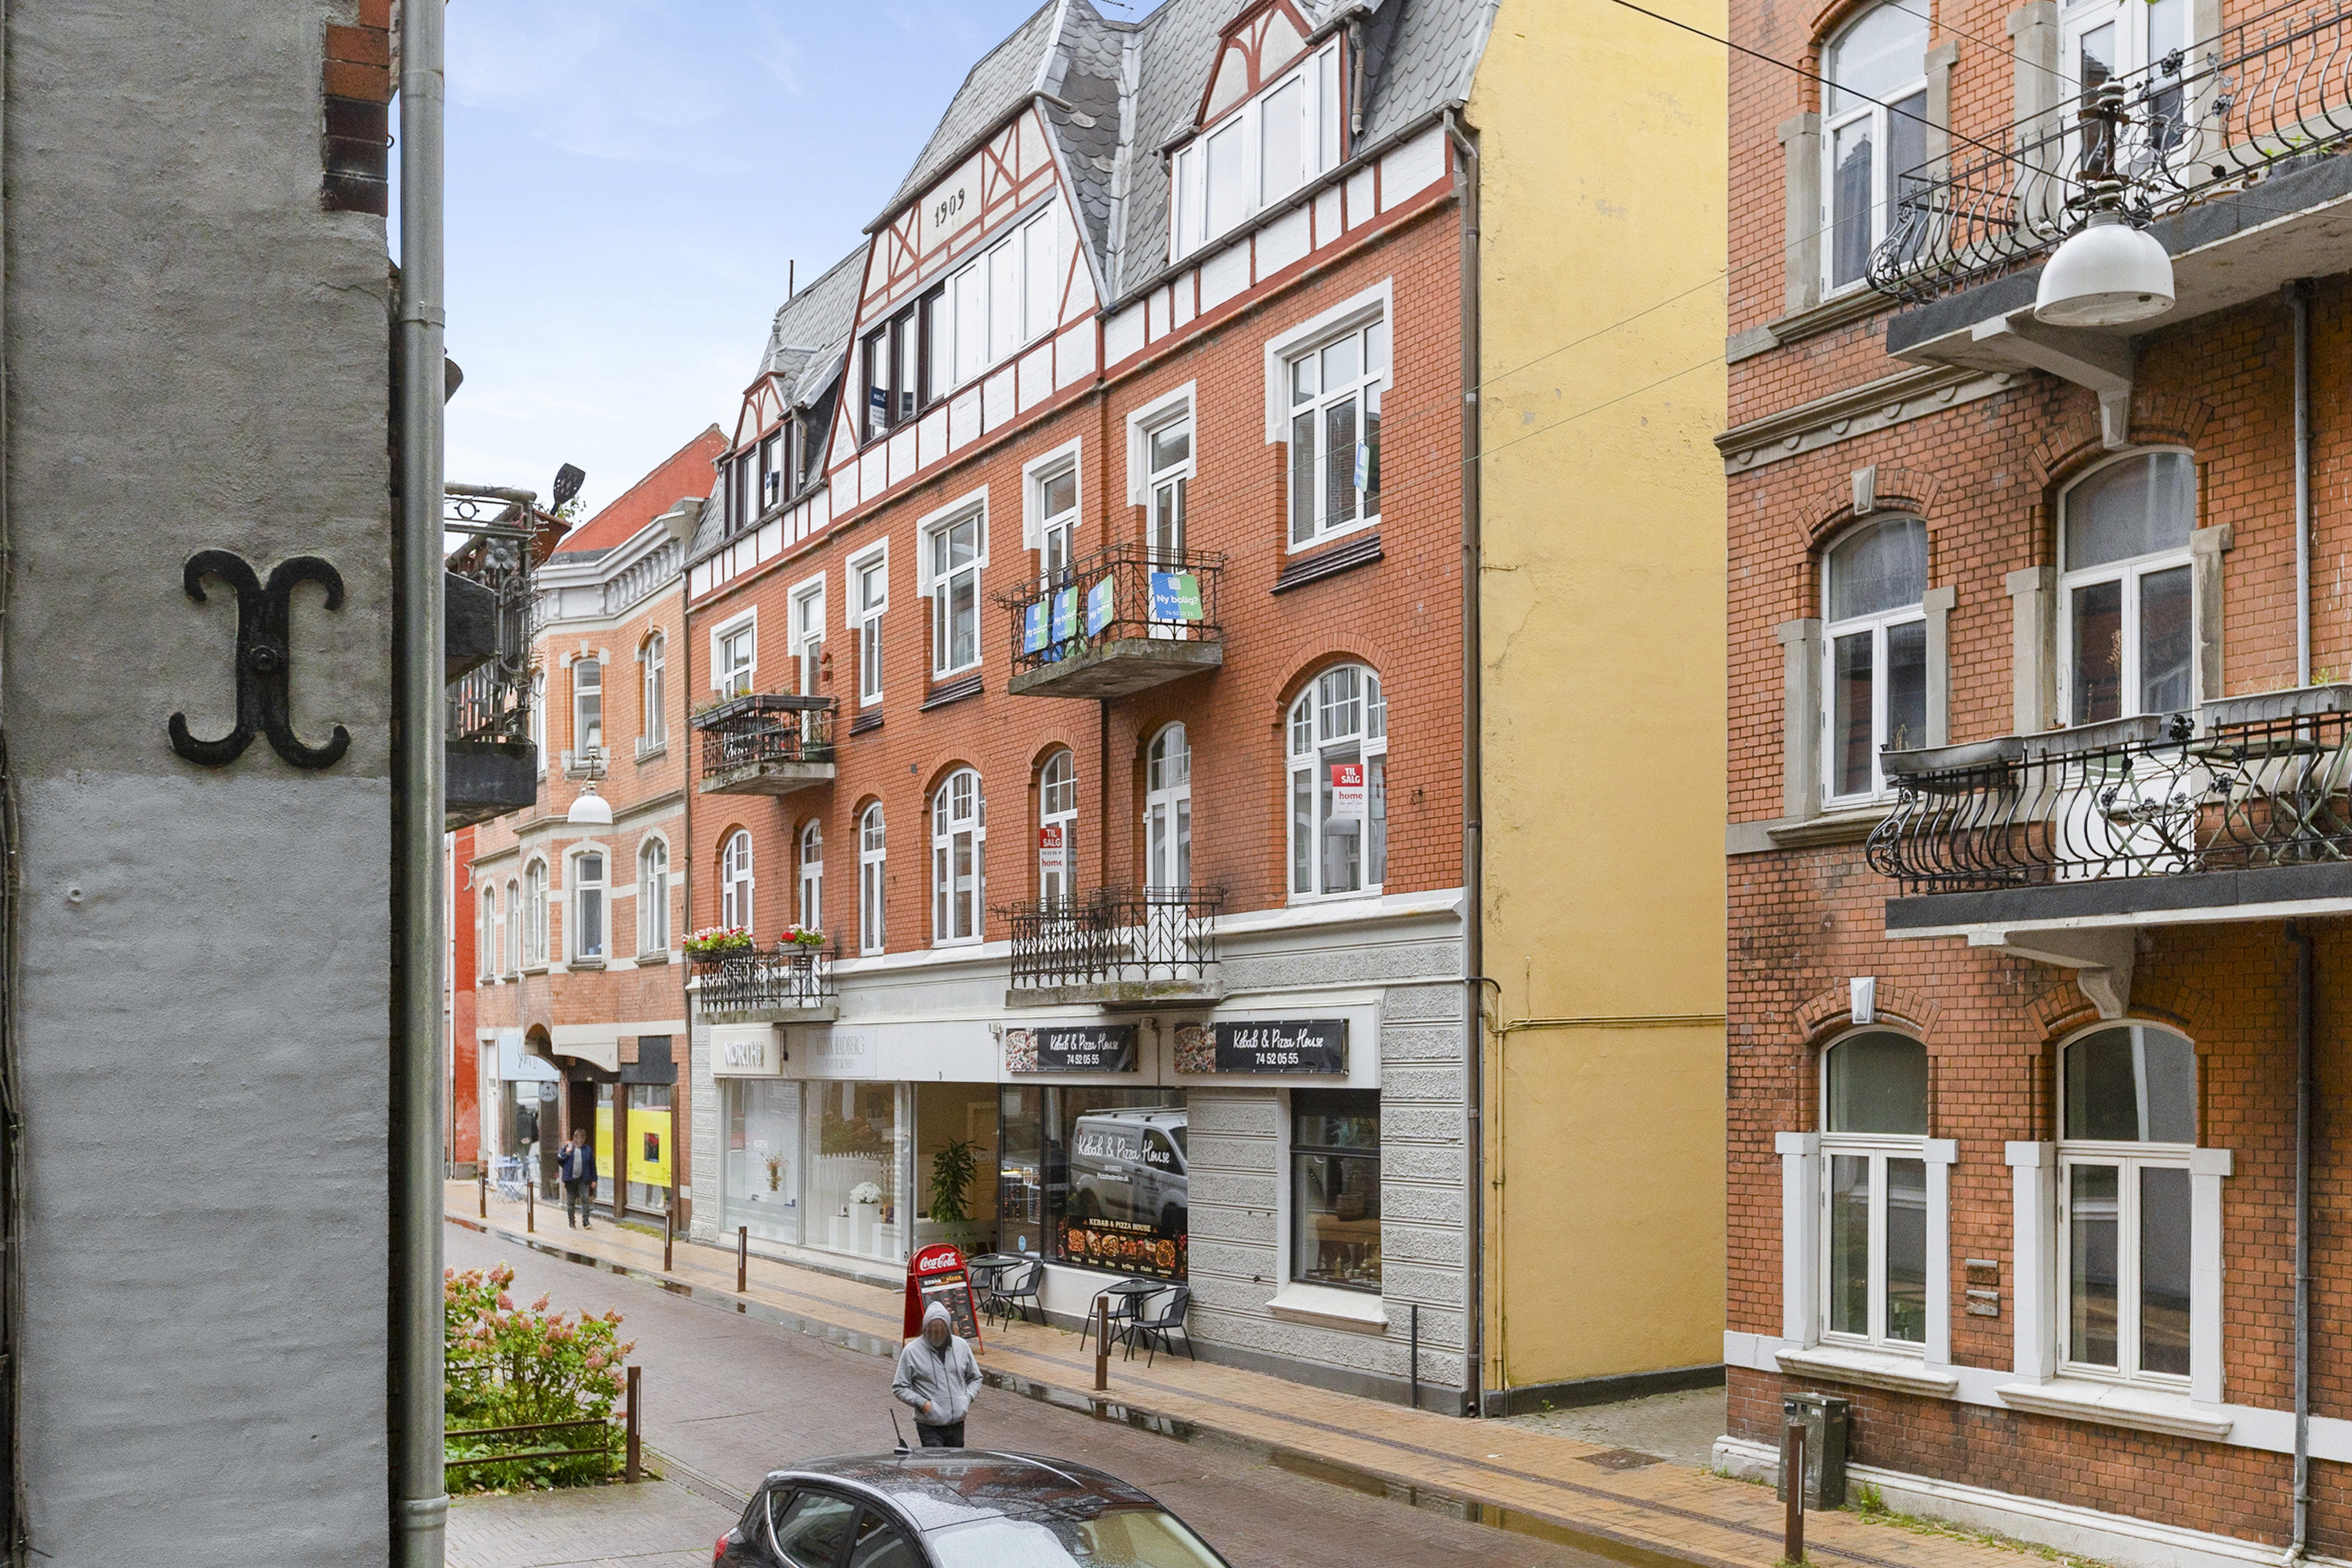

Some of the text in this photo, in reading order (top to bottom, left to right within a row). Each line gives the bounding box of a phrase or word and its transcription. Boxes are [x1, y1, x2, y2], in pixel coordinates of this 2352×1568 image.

[935, 187, 964, 227] 1909
[1156, 594, 1198, 606] Ny bolig?
[1339, 791, 1363, 800] home
[1046, 829, 1057, 837] TIL
[1043, 838, 1061, 847] SALG
[1050, 1033, 1118, 1051] Kebab & Pizza House
[1233, 1028, 1323, 1048] Kebab & Pizza House
[1067, 1054, 1099, 1065] 74 52 05 55
[1256, 1053, 1298, 1064] 74 52 05 55
[1078, 1134, 1171, 1163] Kebab & Pizza House
[1089, 1218, 1109, 1227] KEBAB
[1115, 1221, 1132, 1230] PIZZA
[1132, 1223, 1152, 1232] HOUSE
[920, 1252, 957, 1271] Coca-Cola
